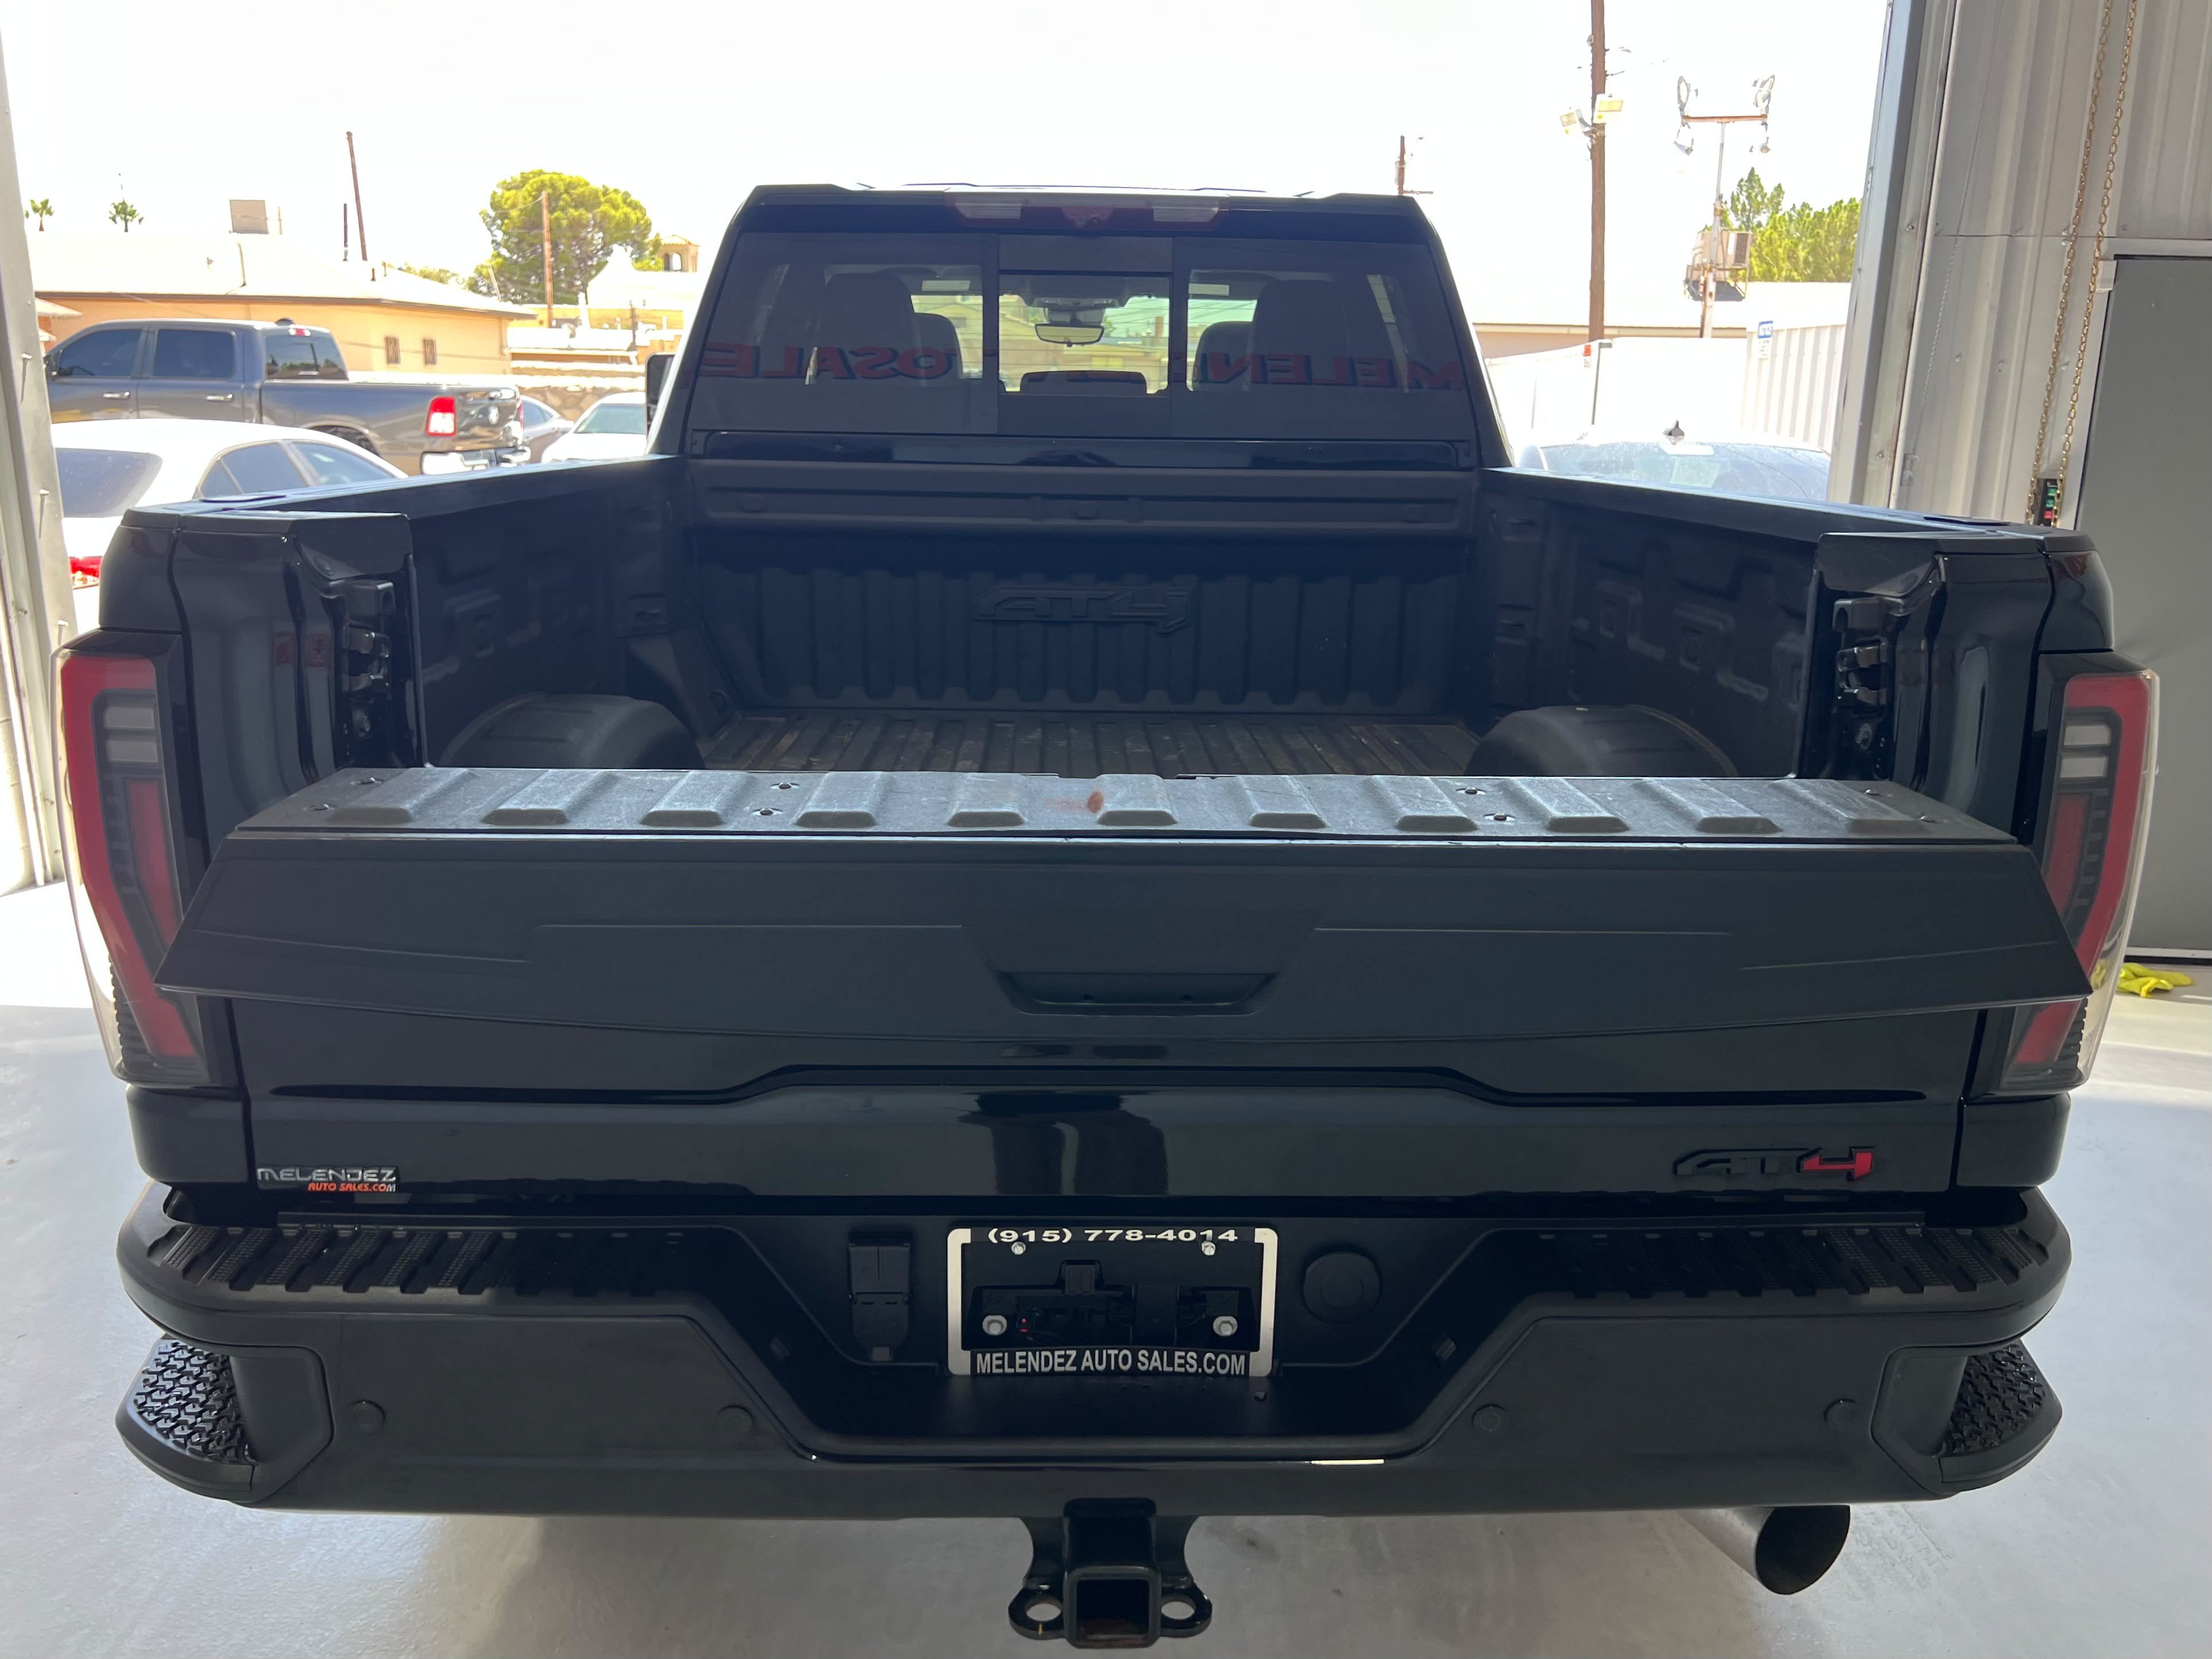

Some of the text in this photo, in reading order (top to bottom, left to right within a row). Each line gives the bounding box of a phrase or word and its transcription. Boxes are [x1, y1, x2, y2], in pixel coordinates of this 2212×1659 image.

[257, 1168, 397, 1182] MELENDEZ
[308, 1183, 396, 1192] AUTO SALES.COM
[988, 1228, 1239, 1244] (915) 778-4014
[977, 1350, 1246, 1375] MELENDEZ AUTO SALES.COM
